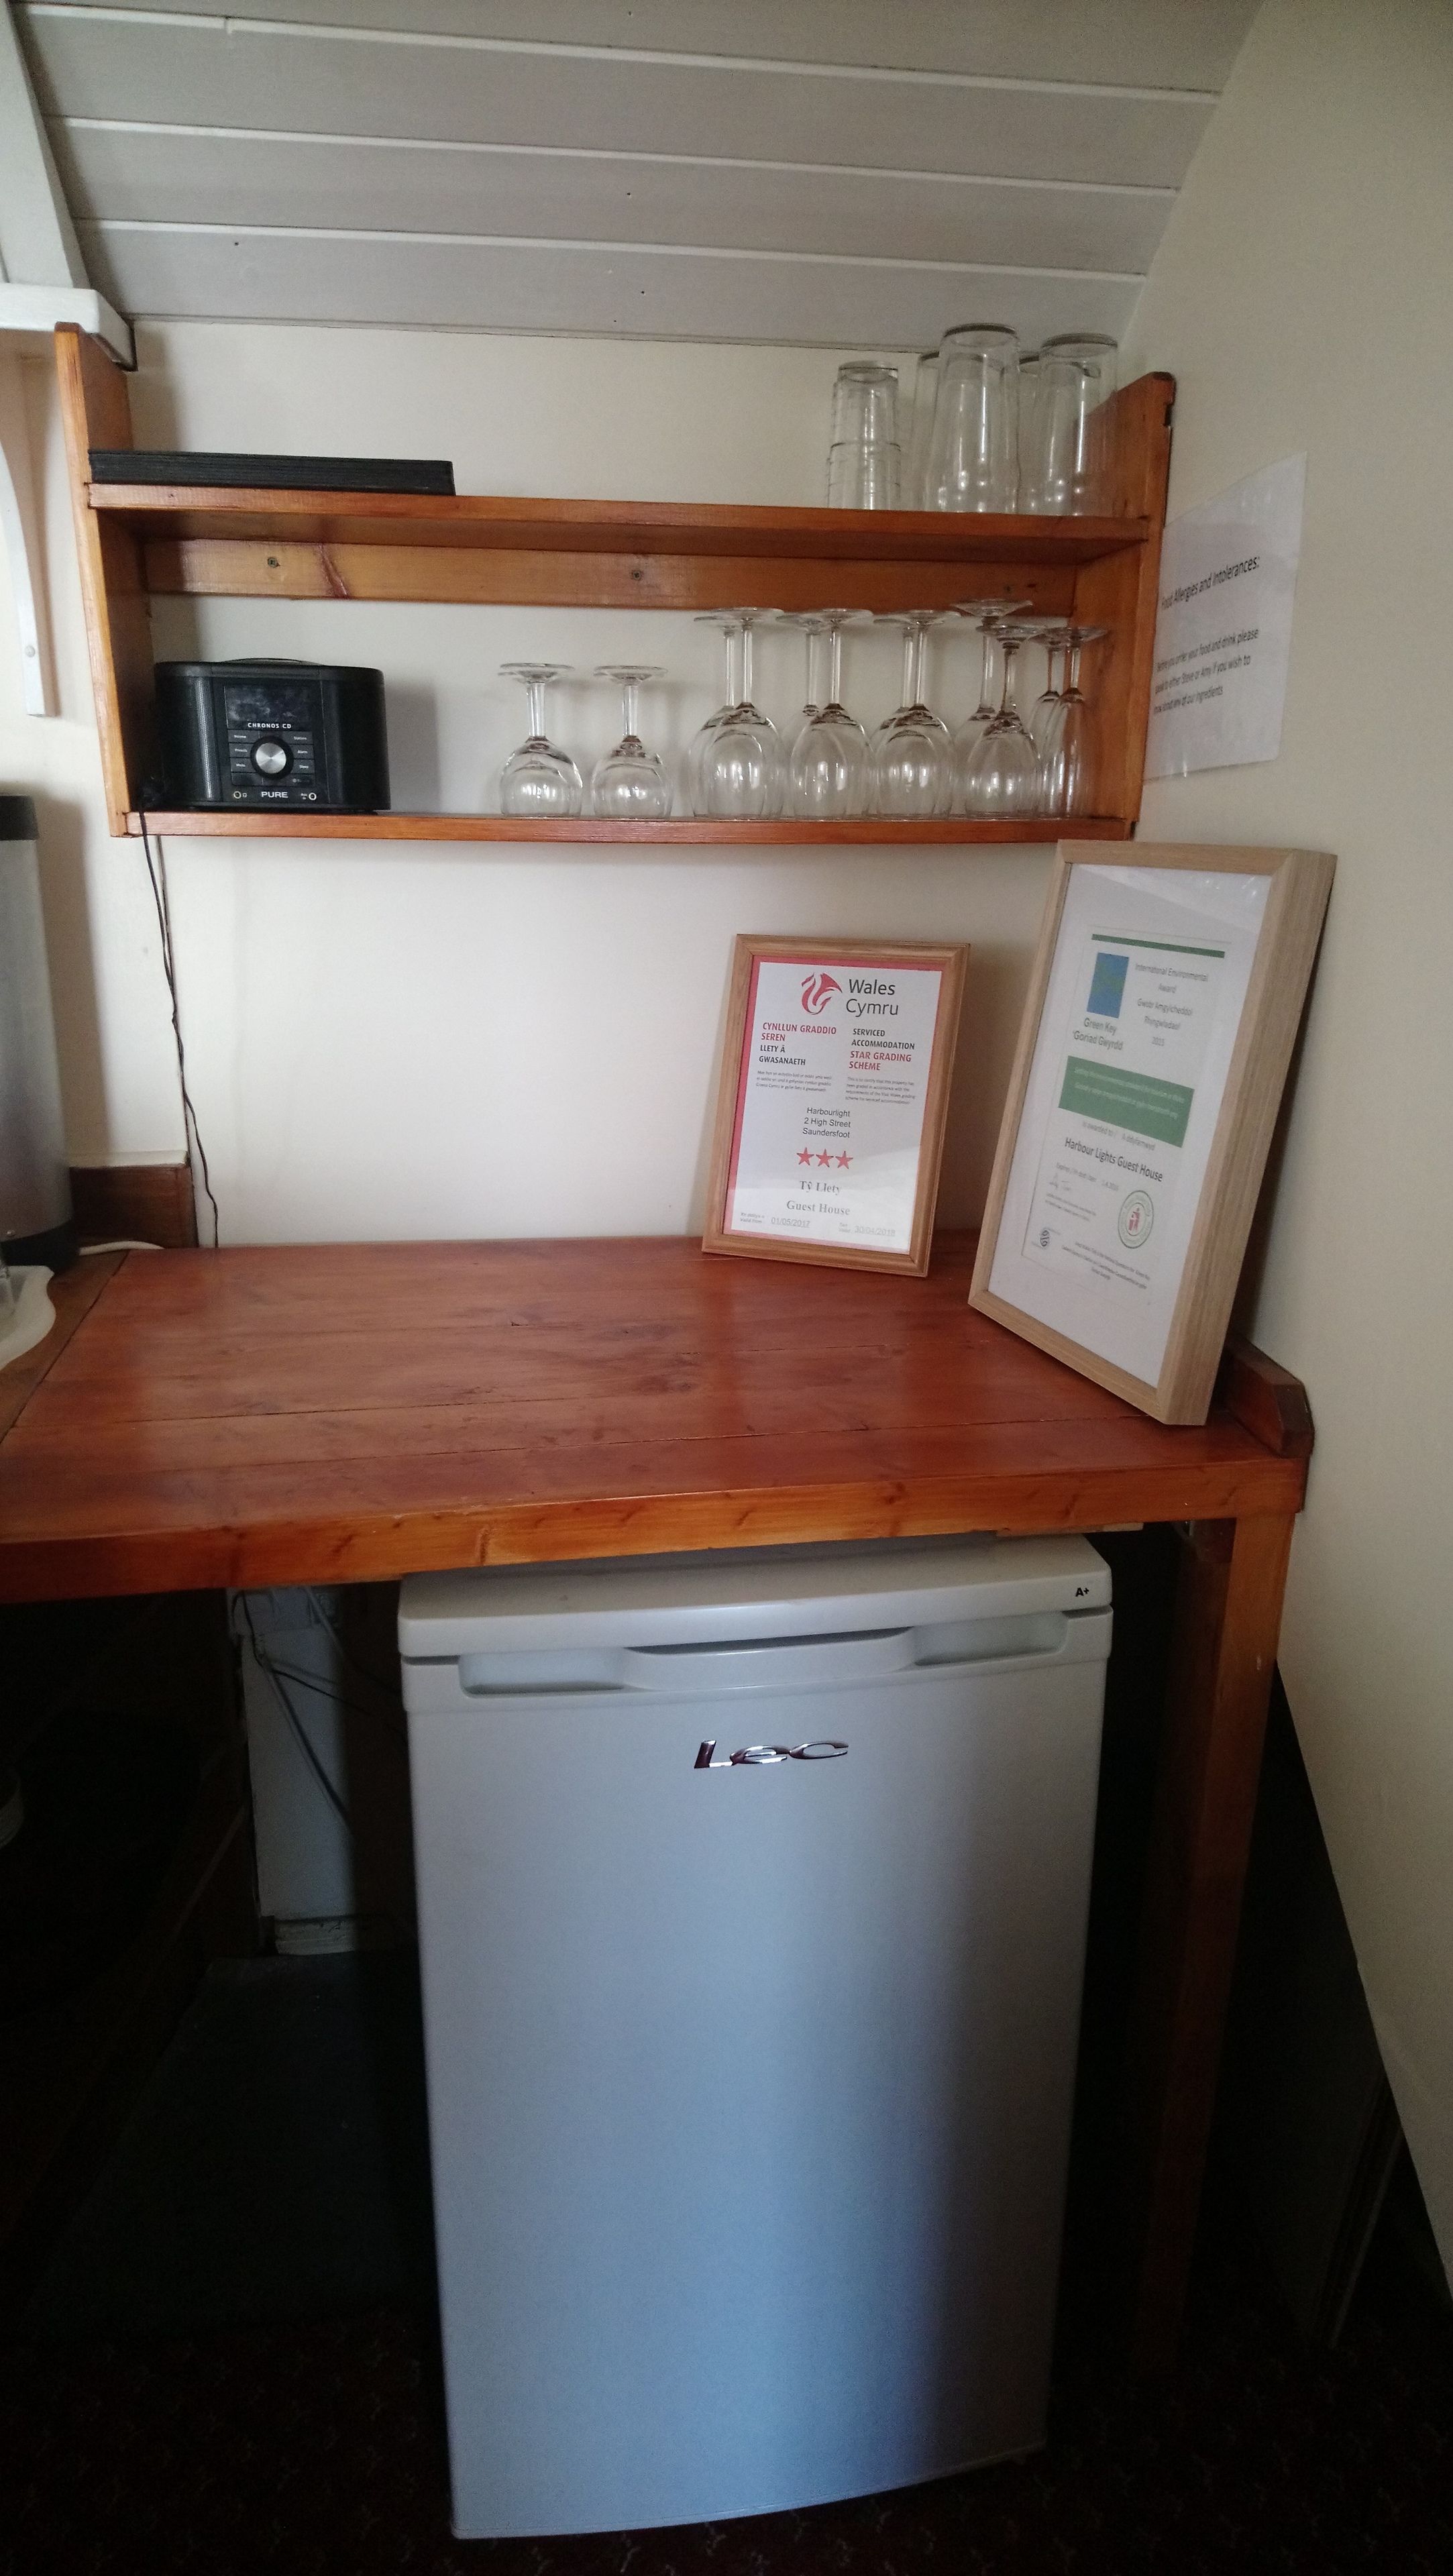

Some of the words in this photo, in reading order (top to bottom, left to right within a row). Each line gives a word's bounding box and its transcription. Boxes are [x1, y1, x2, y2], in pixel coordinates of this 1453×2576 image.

[1199, 572, 1212, 593] and
[1212, 556, 1260, 586] Intolerances:
[1237, 629, 1259, 645] please
[1243, 654, 1250, 665] to
[849, 979, 896, 996] Wales
[846, 998, 899, 1018] Cymru
[763, 1022, 798, 1032] CYNLLUN
[800, 1025, 837, 1034] GRADDIO
[1083, 1017, 1104, 1031] Green
[1105, 1022, 1117, 1035] Key
[761, 1033, 786, 1042] SEREN
[853, 1028, 885, 1037] SERVICED
[851, 1039, 915, 1050] ACCOMMODATION
[1073, 1030, 1097, 1045] Goriad
[1097, 1036, 1124, 1051] Gwyrdd
[760, 1044, 778, 1053] LLETY
[759, 1055, 806, 1066] GWASANAETH
[850, 1051, 870, 1060] STAR
[873, 1052, 912, 1063] GRADING
[849, 1061, 881, 1071] SCHEME
[807, 1107, 851, 1118] Harbourlight
[810, 1118, 827, 1127] High
[829, 1119, 851, 1128] Street
[802, 1127, 850, 1138] Saundersfoot
[1065, 1136, 1094, 1156] Harbour
[1095, 1147, 1116, 1164] Lights
[1117, 1156, 1140, 1173] Guest
[1139, 1163, 1163, 1182] House
[816, 1182, 841, 1195] Llety
[786, 1200, 815, 1212] Guest
[819, 1203, 851, 1216] House
[771, 1217, 810, 1228] 01/05/2017
[1075, 1587, 1089, 1597] A+
